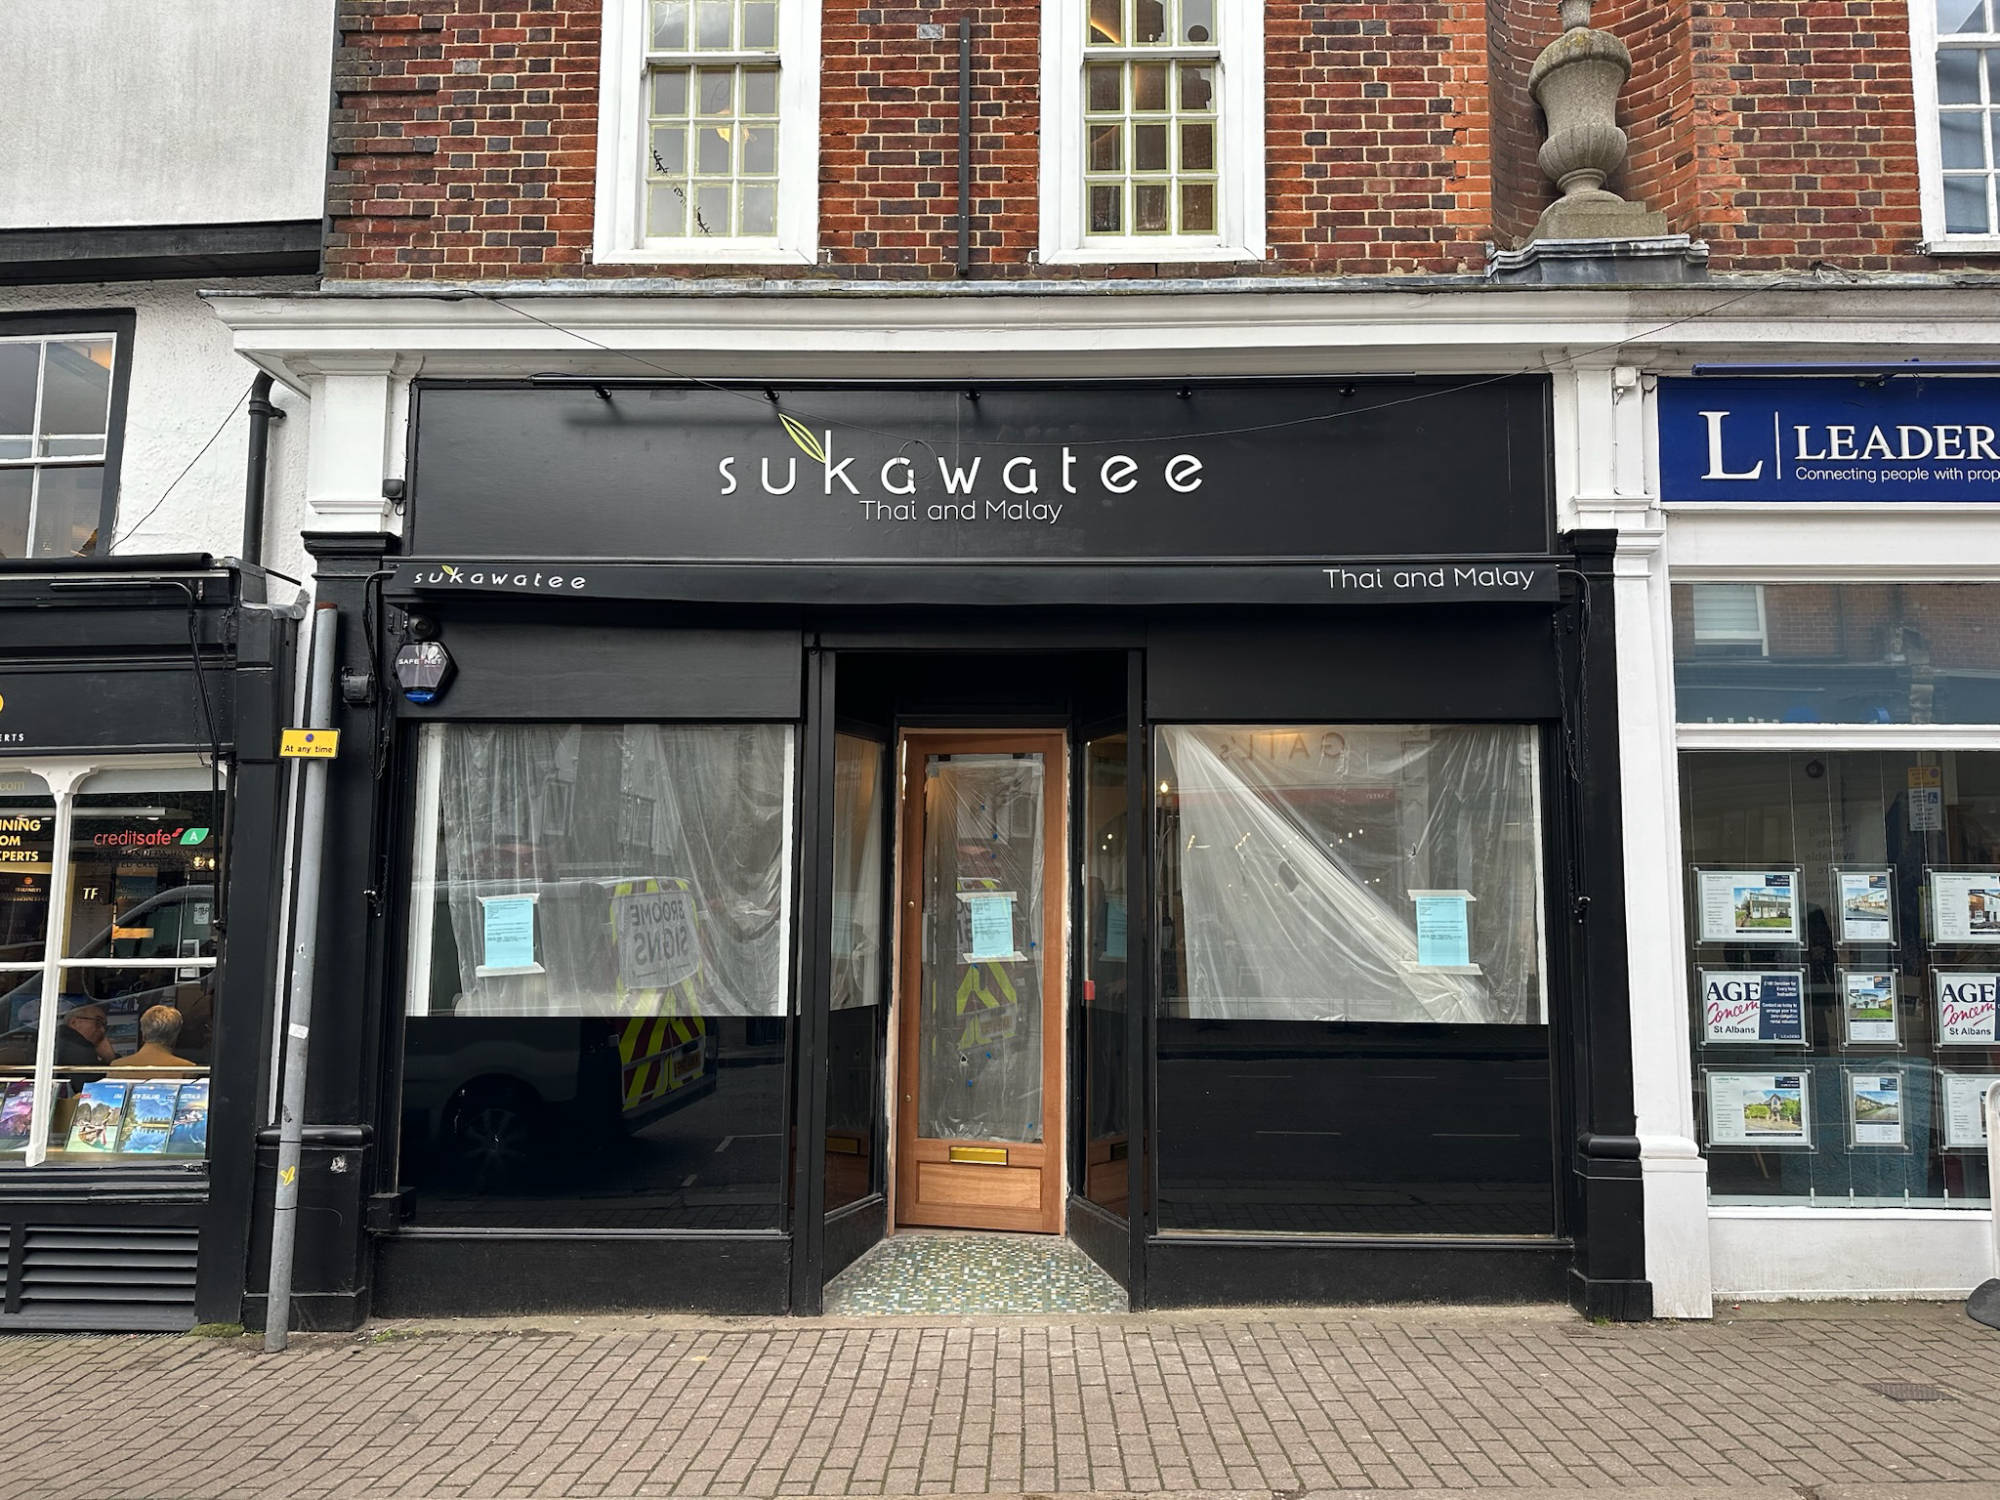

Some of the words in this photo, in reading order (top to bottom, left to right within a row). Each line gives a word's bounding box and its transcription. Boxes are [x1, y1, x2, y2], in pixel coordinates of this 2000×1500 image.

[1699, 411, 1764, 480] L
[719, 429, 1204, 495] sukawatee
[1796, 466, 1877, 484] Connecting
[1881, 467, 1930, 484] people
[1934, 467, 1964, 481] with
[1968, 469, 2000, 484] prop
[859, 500, 917, 521] Thai
[927, 500, 976, 521] and
[985, 500, 1063, 525] Malay
[413, 567, 587, 590] sukawatee
[1322, 568, 1383, 589] Thai
[1393, 568, 1445, 588] and
[1453, 567, 1535, 591] Malay
[297, 746, 311, 754] any
[315, 745, 333, 753] time
[93, 829, 172, 846] creditsafe
[1707, 981, 1760, 1001] AGE
[1941, 983, 1995, 1003] AGE
[1708, 1000, 1760, 1025] Concern
[1713, 1026, 1723, 1034] St
[1725, 1025, 1756, 1034] Albans
[1949, 1027, 1959, 1035] St
[1961, 1027, 1991, 1035] Albans
